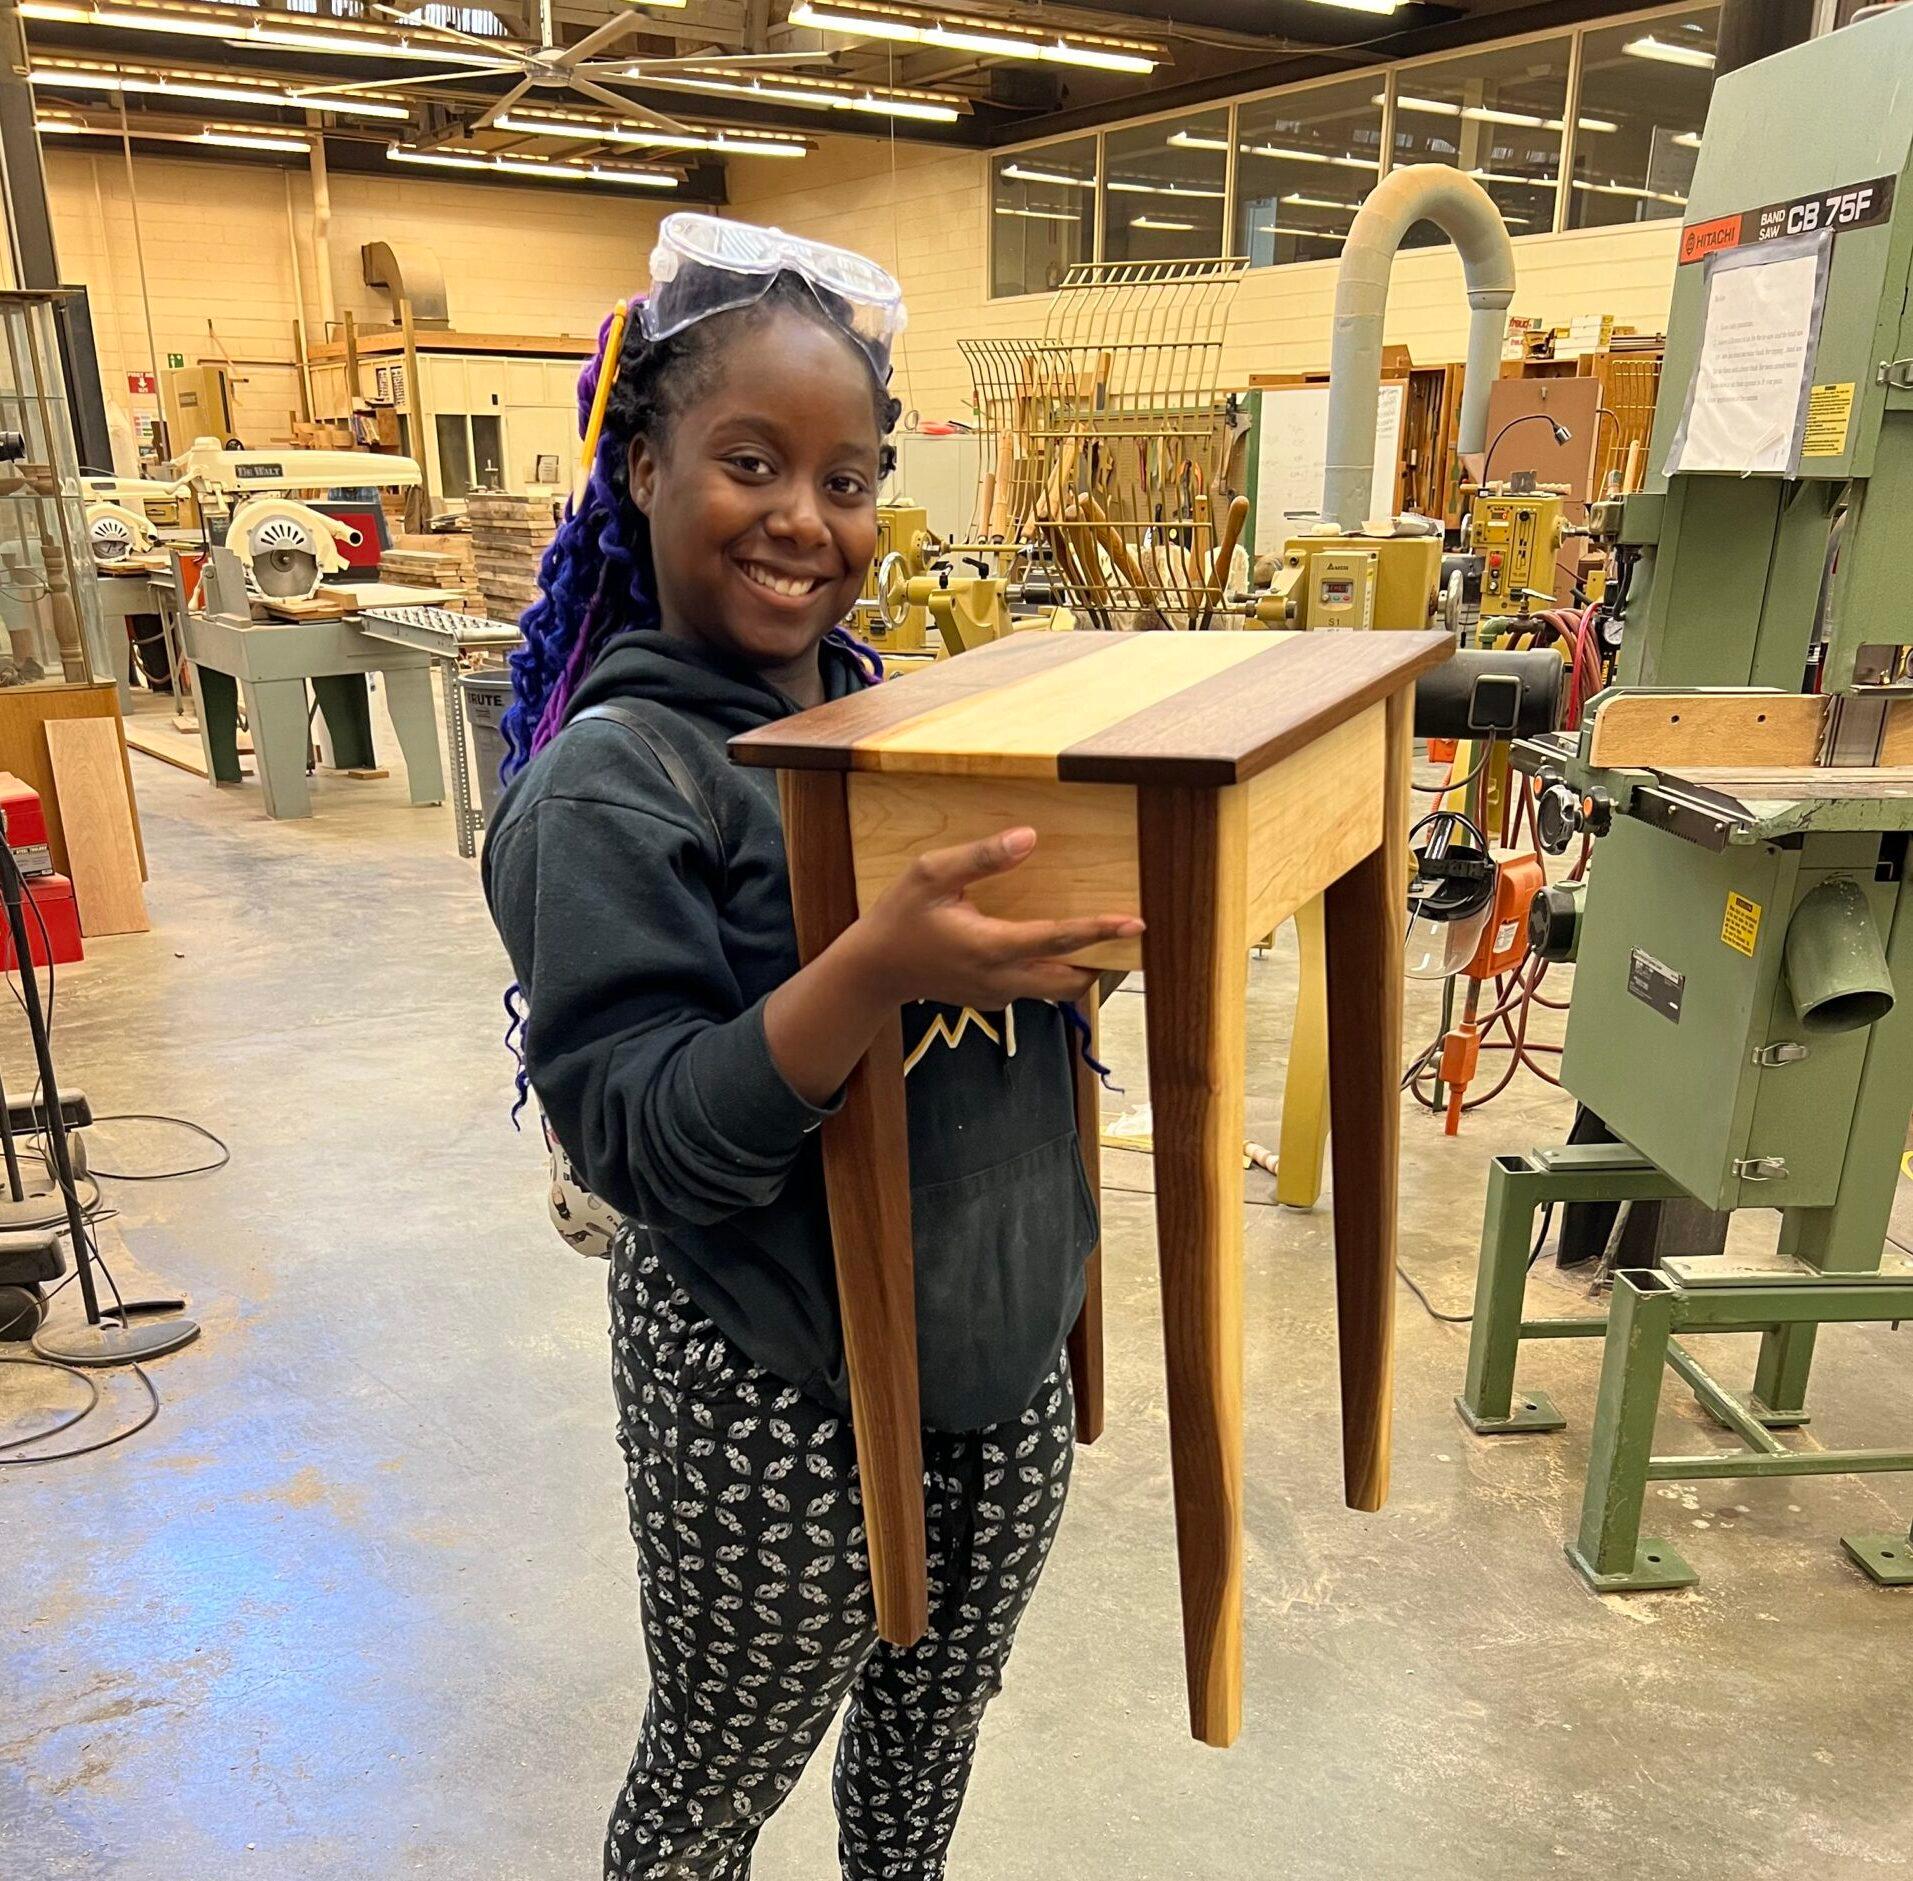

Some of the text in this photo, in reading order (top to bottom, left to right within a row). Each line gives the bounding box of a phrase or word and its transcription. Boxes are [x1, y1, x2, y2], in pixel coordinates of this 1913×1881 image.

[1761, 209, 1785, 226] BAND
[1787, 189, 1873, 235] CB 75F
[1696, 227, 1735, 248] HITACHI
[1759, 225, 1780, 241] SAW
